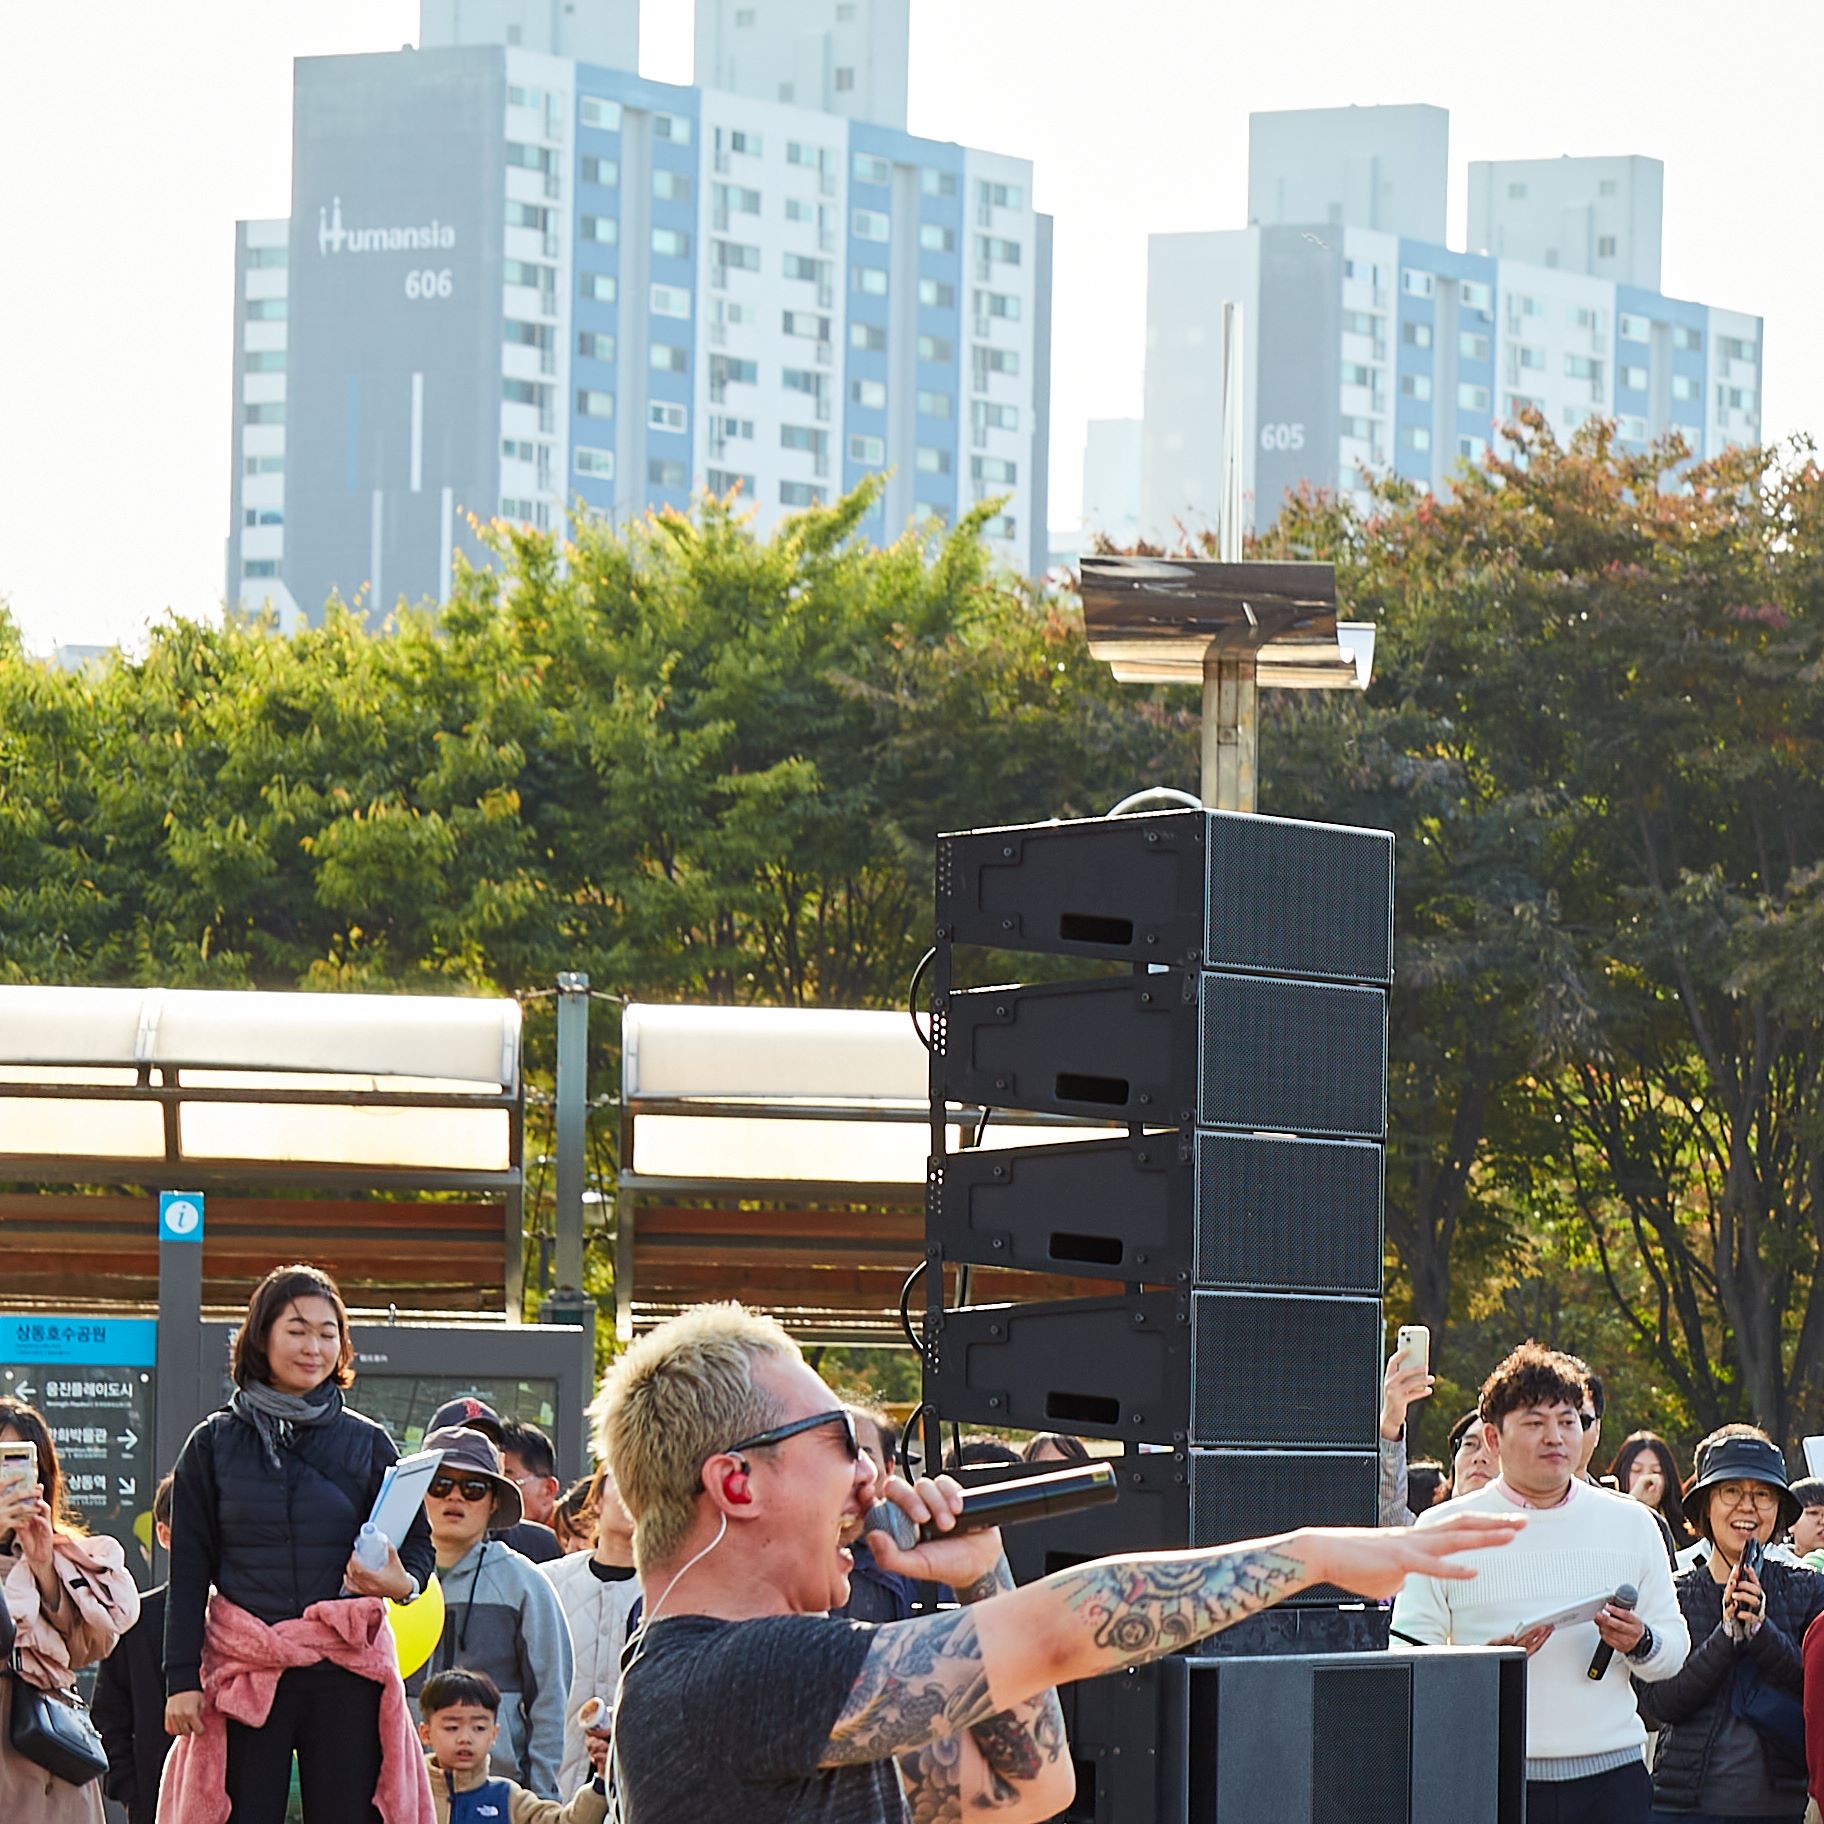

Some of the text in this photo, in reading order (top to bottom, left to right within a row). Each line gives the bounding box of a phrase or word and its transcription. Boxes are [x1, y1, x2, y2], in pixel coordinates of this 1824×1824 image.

[318, 195, 456, 257] Humansia
[404, 268, 453, 300] 606
[1260, 423, 1305, 451] 605
[16, 1324, 107, 1343] 상동호수공원
[46, 1381, 133, 1398] 웅진플레이도시
[68, 1474, 106, 1490] 상동역
